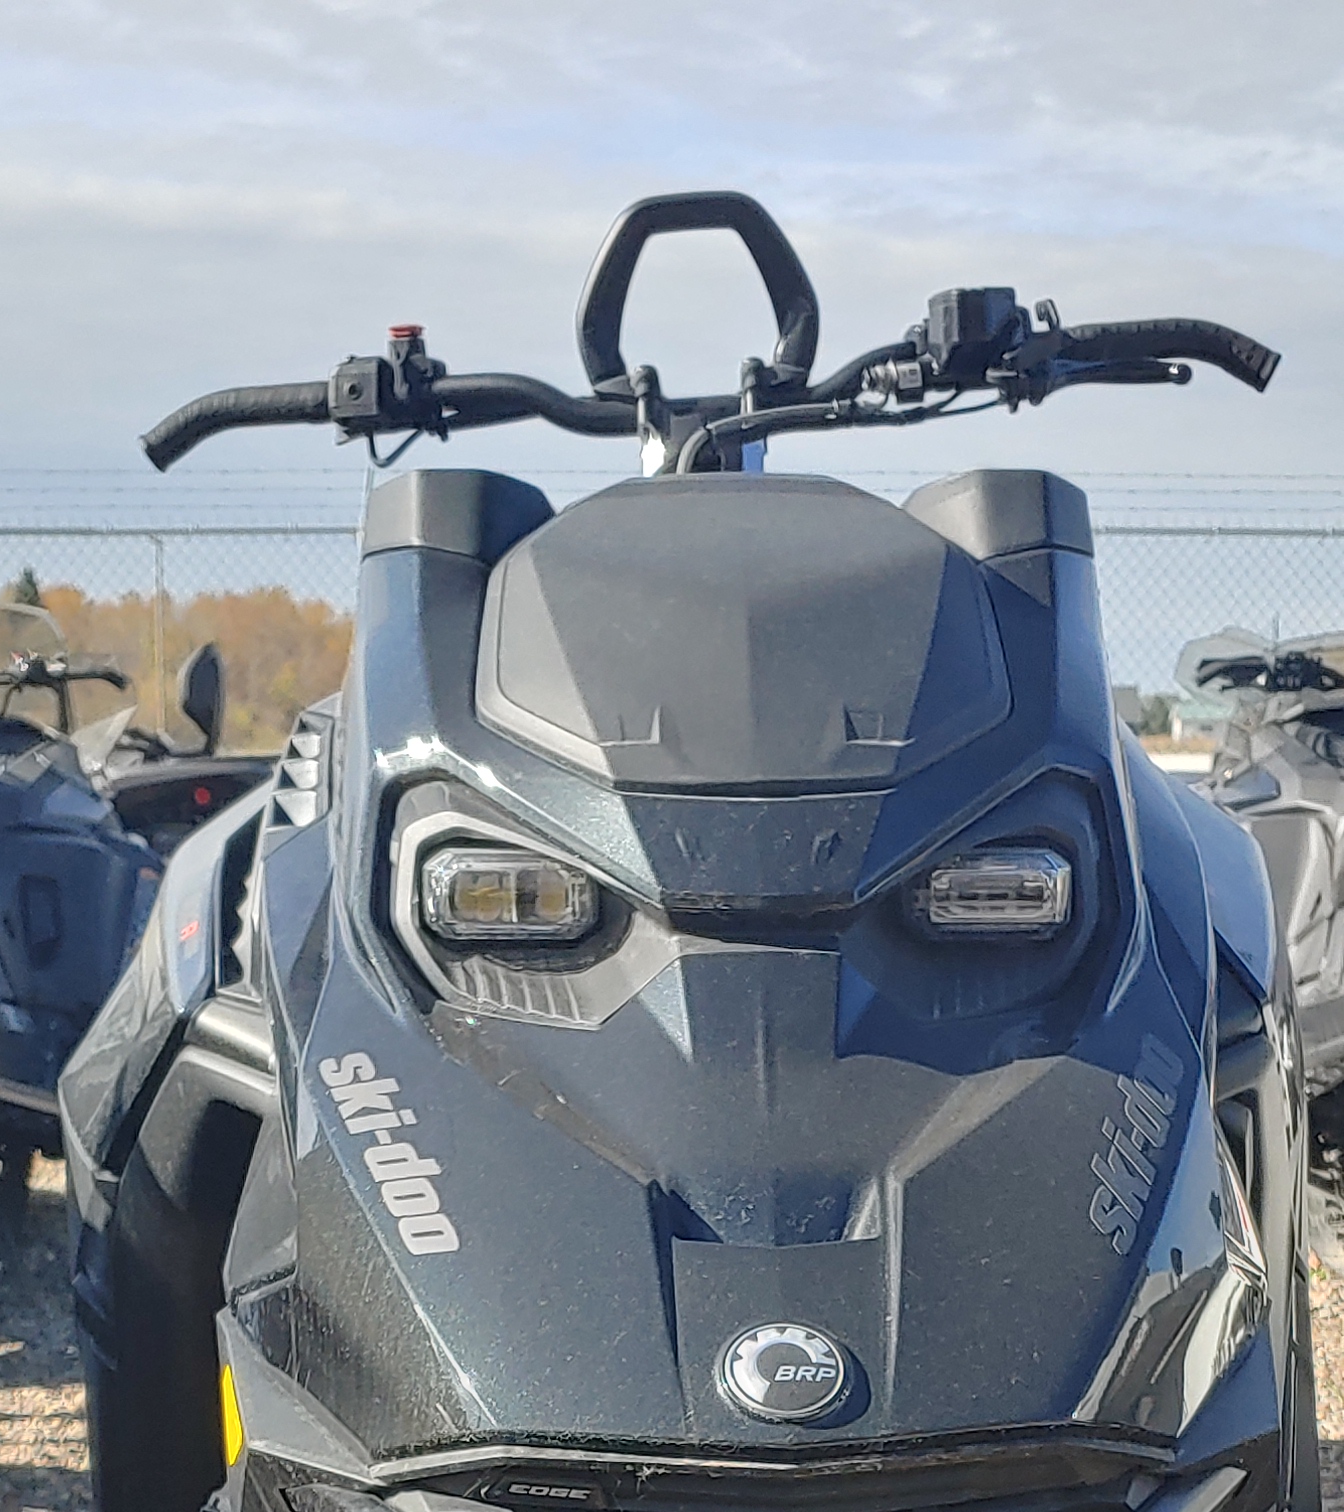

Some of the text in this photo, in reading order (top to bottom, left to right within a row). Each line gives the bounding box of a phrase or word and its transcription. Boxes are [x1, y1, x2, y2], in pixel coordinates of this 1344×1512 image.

[319, 1052, 460, 1256] ski-doo
[1090, 1033, 1184, 1255] ski-doo
[774, 1365, 836, 1382] BRP
[508, 1483, 591, 1499] EDGE
